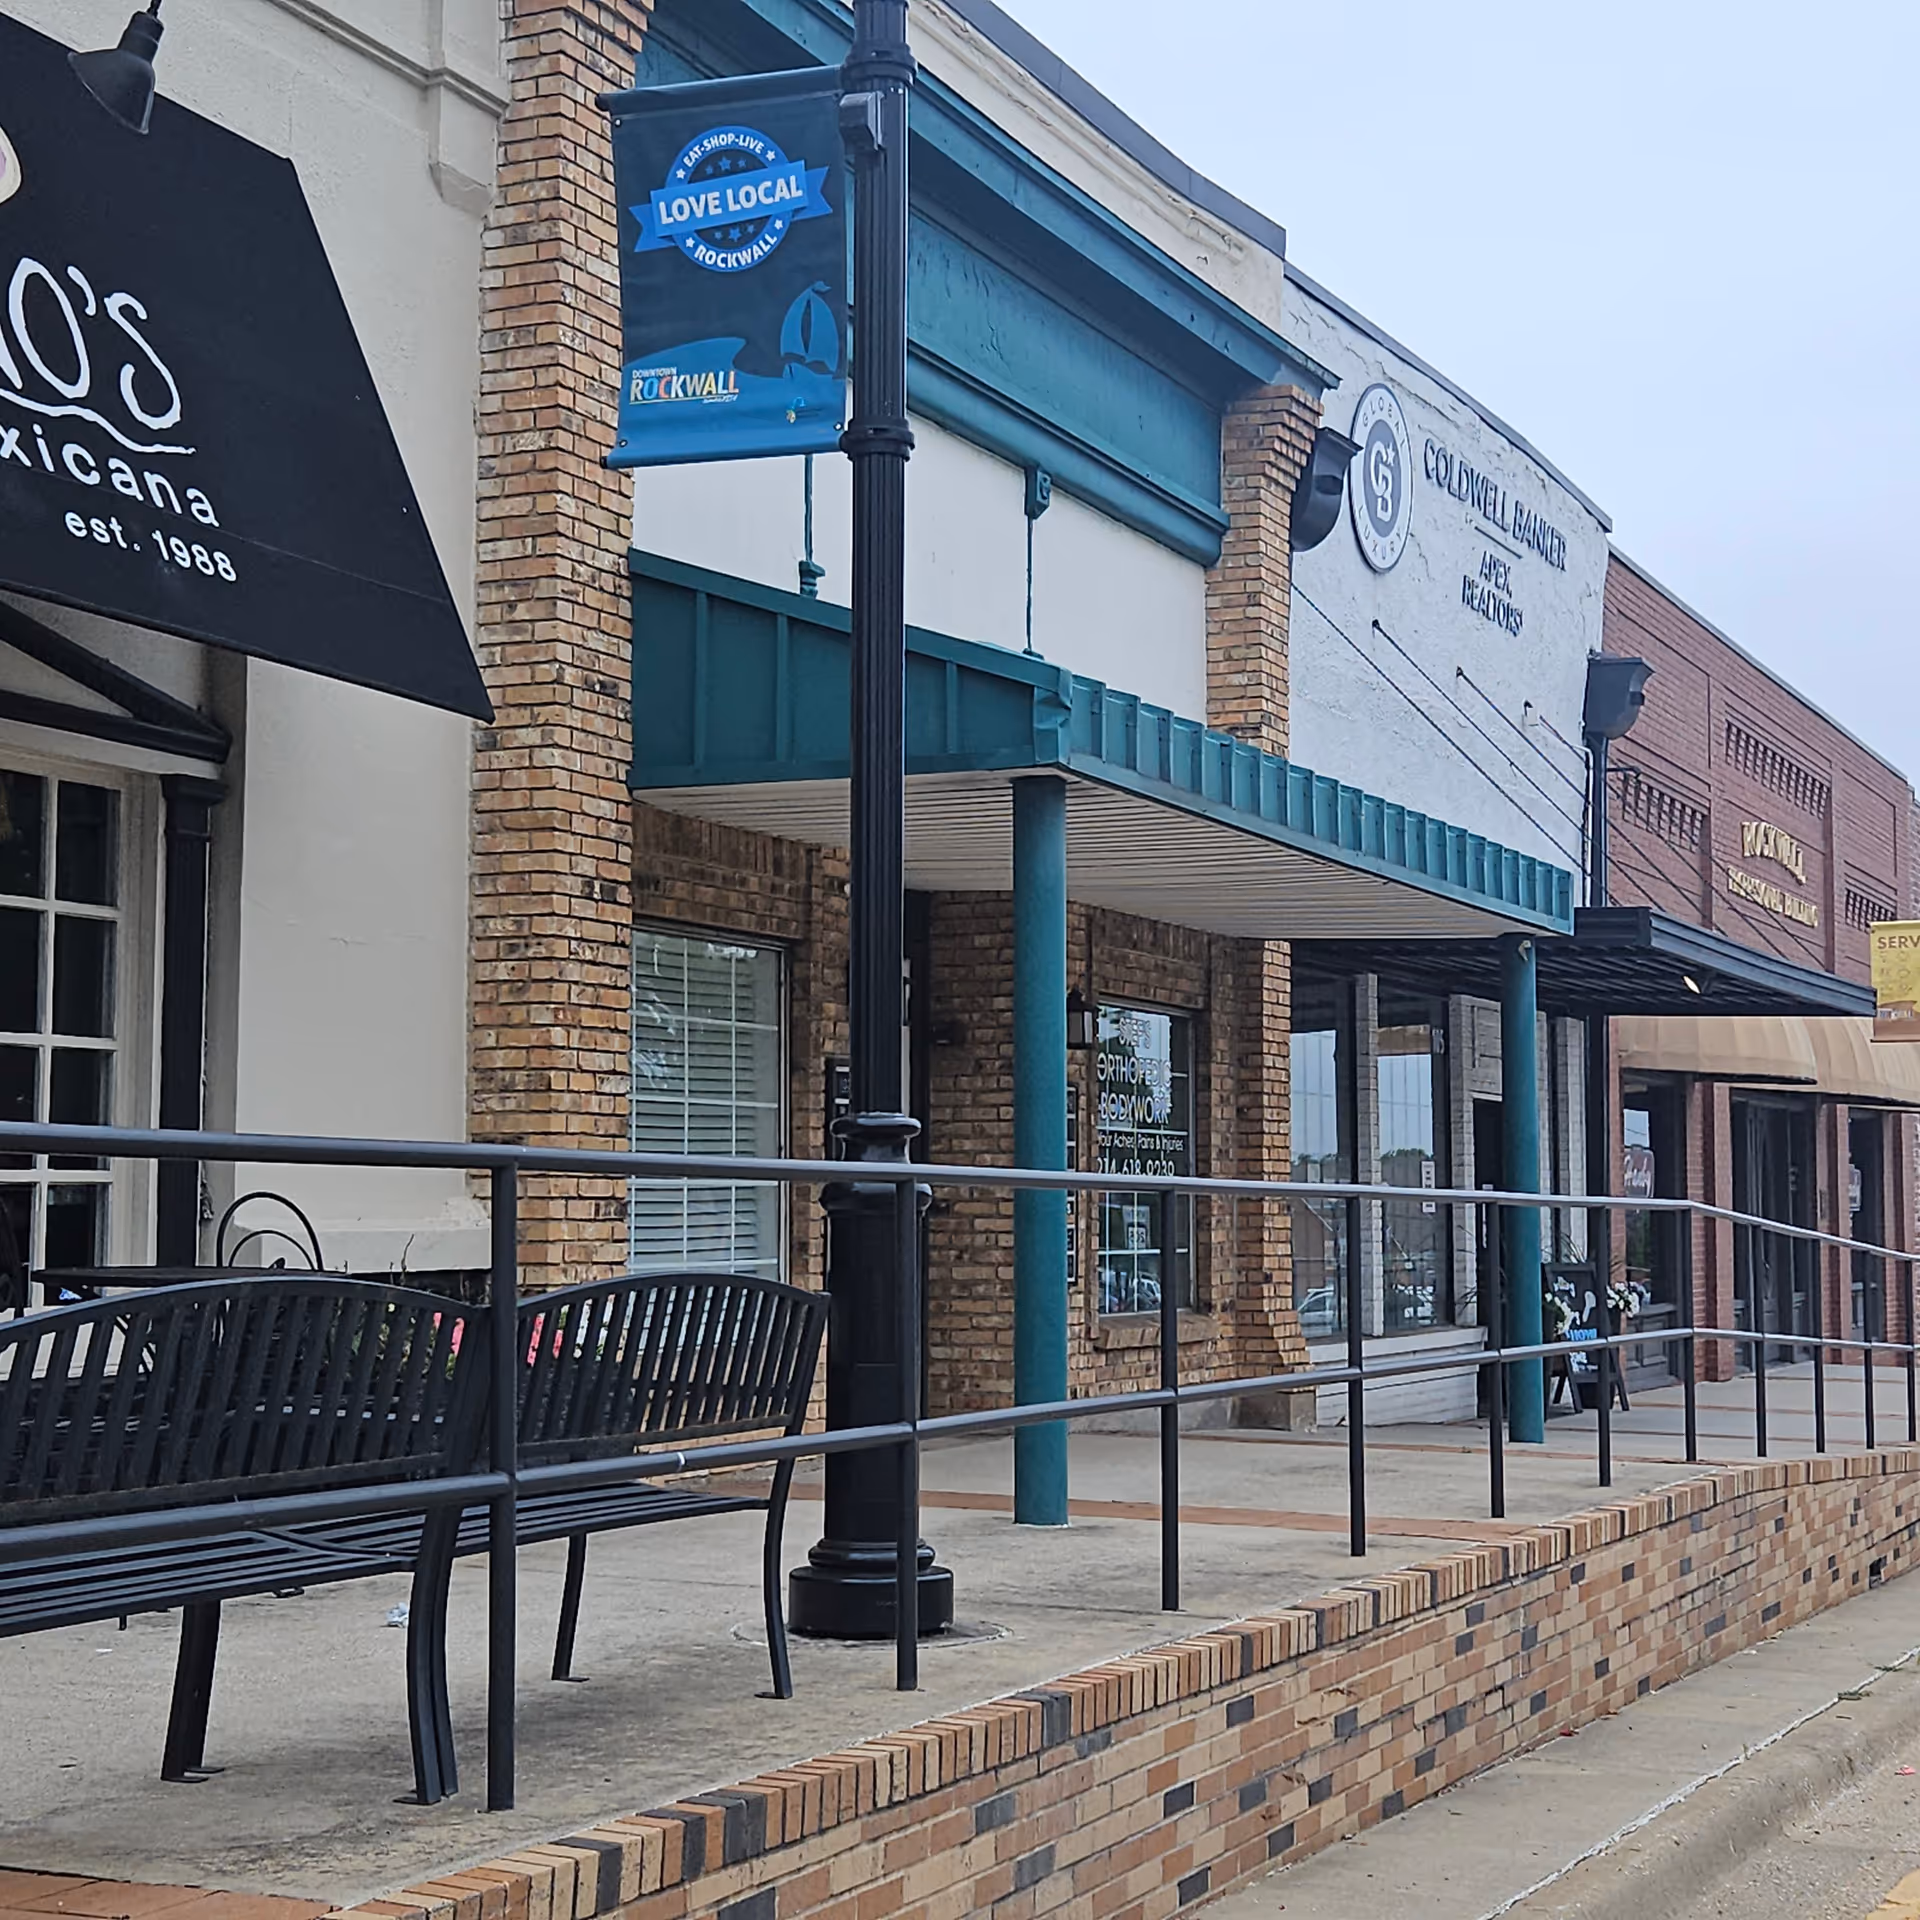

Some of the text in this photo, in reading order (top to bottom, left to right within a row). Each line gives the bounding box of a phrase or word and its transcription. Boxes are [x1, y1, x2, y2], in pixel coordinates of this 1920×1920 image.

[683, 132, 765, 168] EAT-SHOP-LIVE
[658, 175, 803, 225] LOVE LOCAL
[694, 232, 778, 268] ROCKWALL
[0, 257, 181, 430] O'S
[630, 370, 739, 402] ROCKWALL
[632, 366, 677, 379] DOWNTOWN
[1424, 438, 1567, 573] COLDWELL BANKER
[65, 511, 237, 582] est. 1988
[1358, 503, 1401, 561] LUXURY
[1101, 1091, 1169, 1125] BODYWORK
